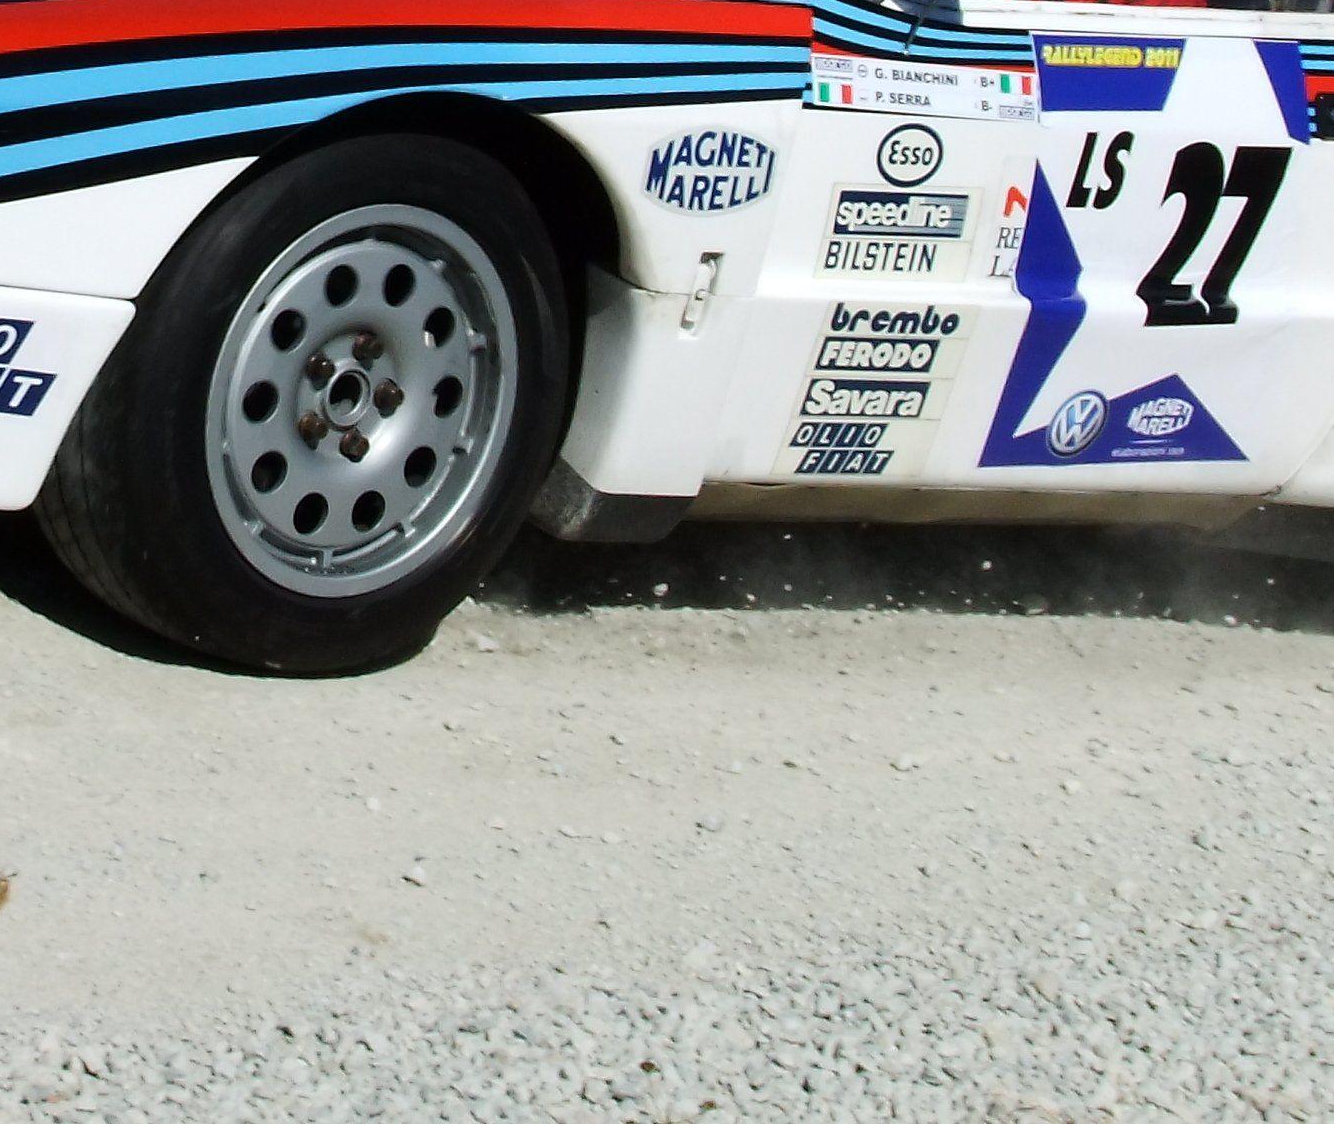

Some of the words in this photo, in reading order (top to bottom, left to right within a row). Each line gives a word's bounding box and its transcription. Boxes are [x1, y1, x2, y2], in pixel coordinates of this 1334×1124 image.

[875, 68, 887, 79] G.
[892, 69, 958, 86] BIANCHINI
[875, 92, 885, 103] P.
[889, 93, 932, 106] SERRA
[649, 131, 774, 180] MAGNETI
[646, 160, 770, 212] MARELLI
[836, 196, 953, 231] speedline
[1066, 131, 1134, 209] LS
[1136, 142, 1294, 327] 27
[823, 240, 938, 273] BILSTEIN
[830, 302, 960, 335] brembo
[819, 341, 933, 369] FERODO
[805, 380, 924, 417] Savara
[796, 425, 884, 446] OLIO
[802, 452, 892, 473] FIAT
